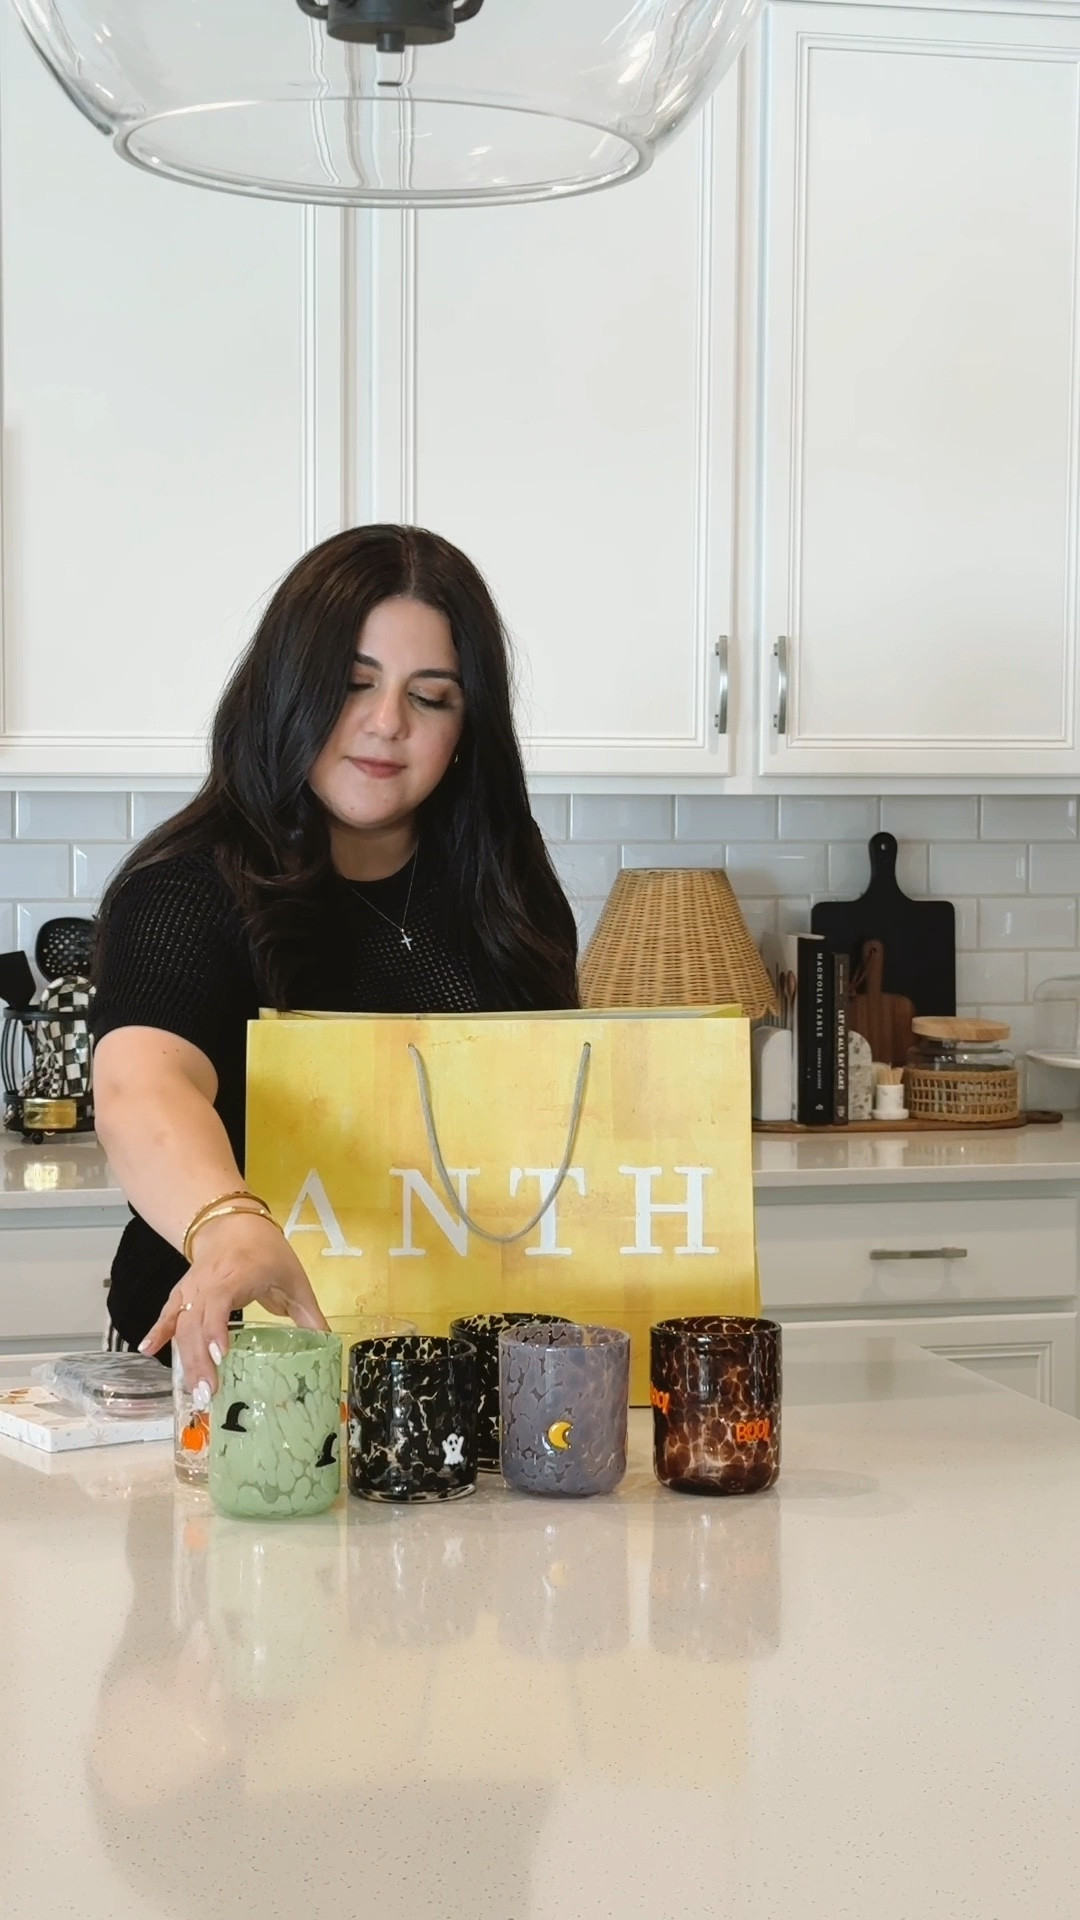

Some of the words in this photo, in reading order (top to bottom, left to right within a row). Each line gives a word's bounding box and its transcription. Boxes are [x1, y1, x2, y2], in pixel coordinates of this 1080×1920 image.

[838, 1025, 845, 1036] US
[284, 1166, 719, 1257] ANTH
[736, 1418, 770, 1443] BOO!
